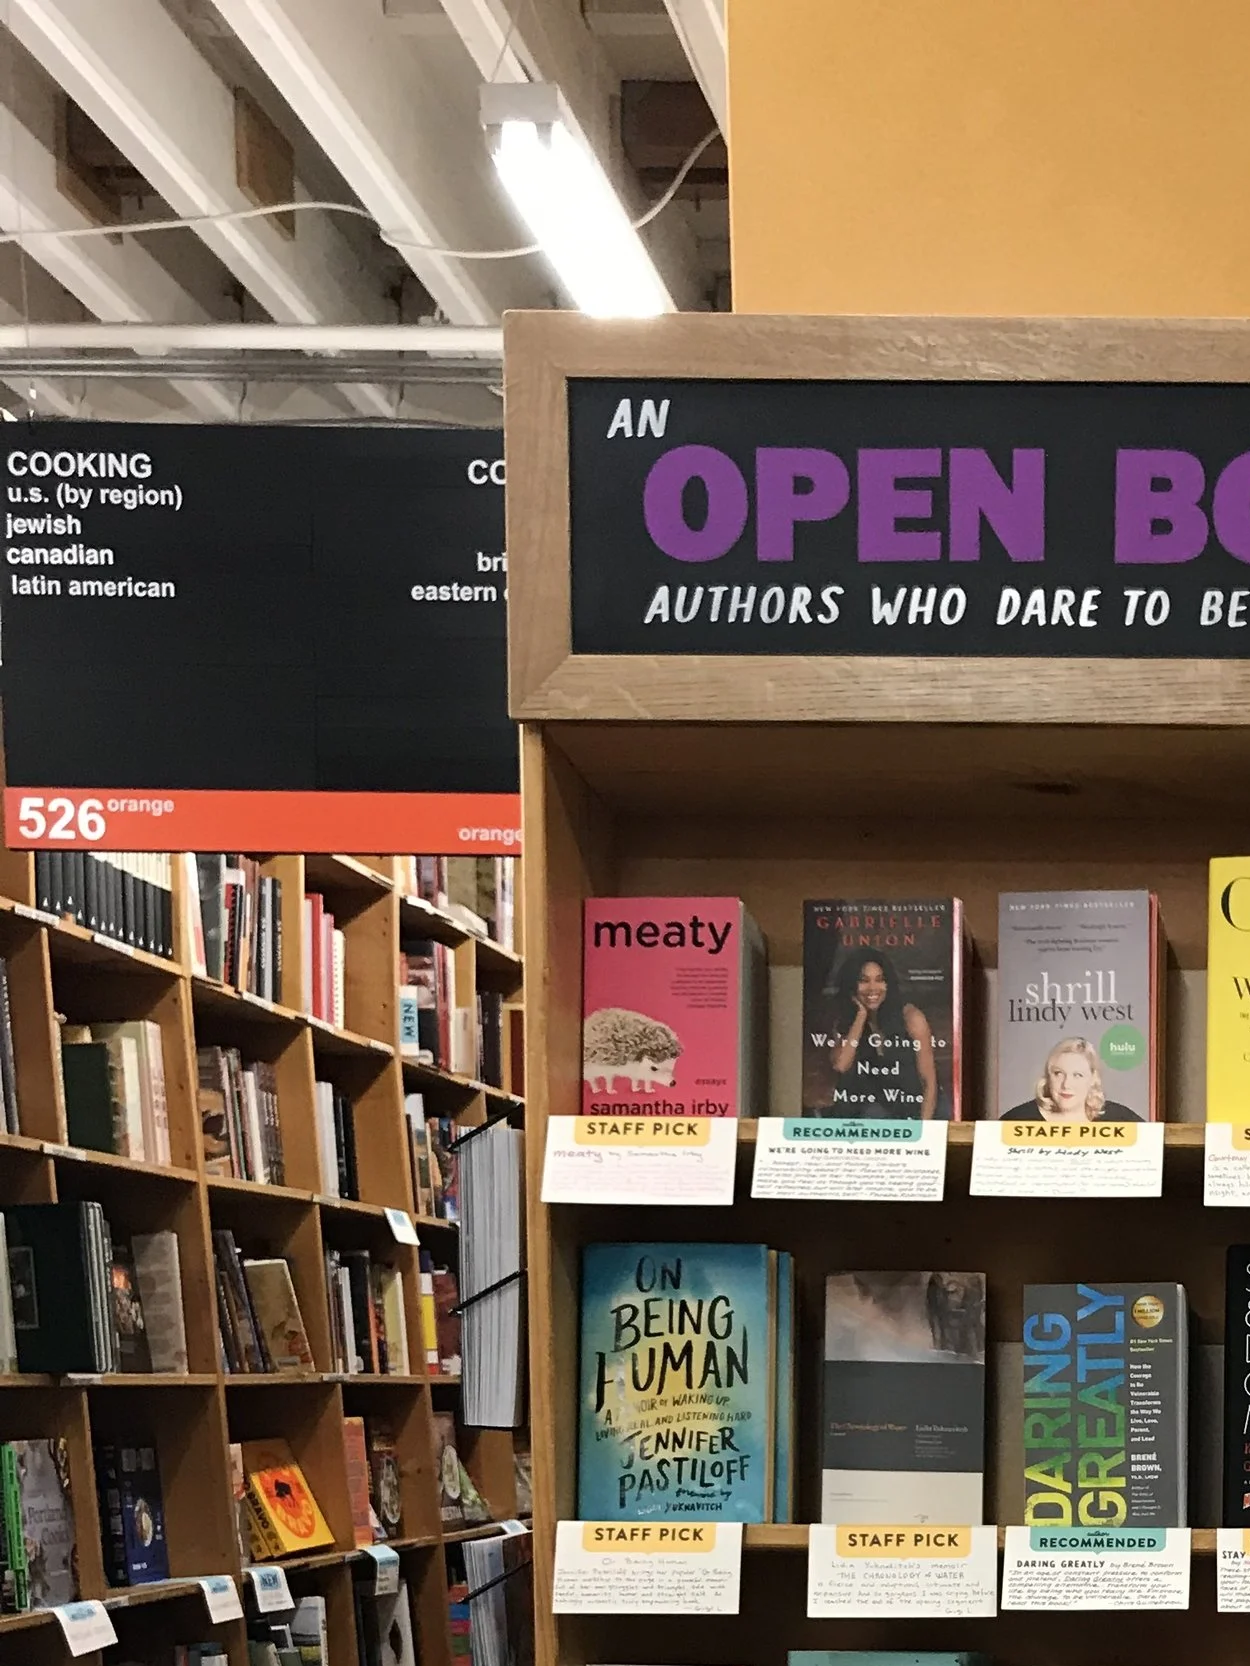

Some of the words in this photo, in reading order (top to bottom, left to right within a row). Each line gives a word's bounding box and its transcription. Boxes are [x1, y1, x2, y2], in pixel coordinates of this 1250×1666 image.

[607, 400, 671, 440] AN
[7, 453, 151, 478] COOKING
[8, 486, 48, 504] u.s.
[57, 485, 93, 509] (by
[100, 486, 183, 511] region)
[643, 445, 1047, 562] OPEN
[6, 514, 81, 536] jewish
[7, 545, 114, 566] canadian
[11, 576, 61, 597] latin
[68, 579, 176, 598] american
[411, 582, 496, 602] eastern
[643, 585, 841, 625] AUTHORS
[872, 587, 967, 626] WHO
[996, 587, 1100, 628] DARE
[1124, 589, 1169, 626] TO
[1201, 589, 1248, 627] BE
[18, 798, 106, 840] 526
[108, 795, 174, 816] orange
[458, 825, 523, 843] orange
[594, 916, 731, 955] meaty
[1025, 971, 1118, 1004] shrill
[1009, 999, 1072, 1028] lindy
[1082, 1003, 1134, 1021] west
[811, 1033, 858, 1048] We're
[869, 1033, 922, 1050] Going
[931, 1035, 947, 1048] to
[1110, 1042, 1136, 1054] hulu
[591, 1100, 685, 1116] samantha
[692, 1100, 729, 1117] irby
[587, 1122, 644, 1136] STAFF
[653, 1123, 698, 1136] PICK
[793, 1127, 913, 1138] RECOMMENDED
[611, 1296, 734, 1353] BEING
[595, 1325, 749, 1413] HUMAN
[1077, 1284, 1128, 1528] GREATLY
[1024, 1313, 1072, 1527] DARING
[622, 1427, 739, 1469] JENNIFER
[618, 1455, 750, 1508] PASTILOFF
[849, 1533, 905, 1546] STAFF
[914, 1533, 959, 1547] PICK
[1040, 1537, 1157, 1548] RECOMMENDED
[1017, 1560, 1058, 1568] DARING
[1061, 1561, 1105, 1569] GREATLY
